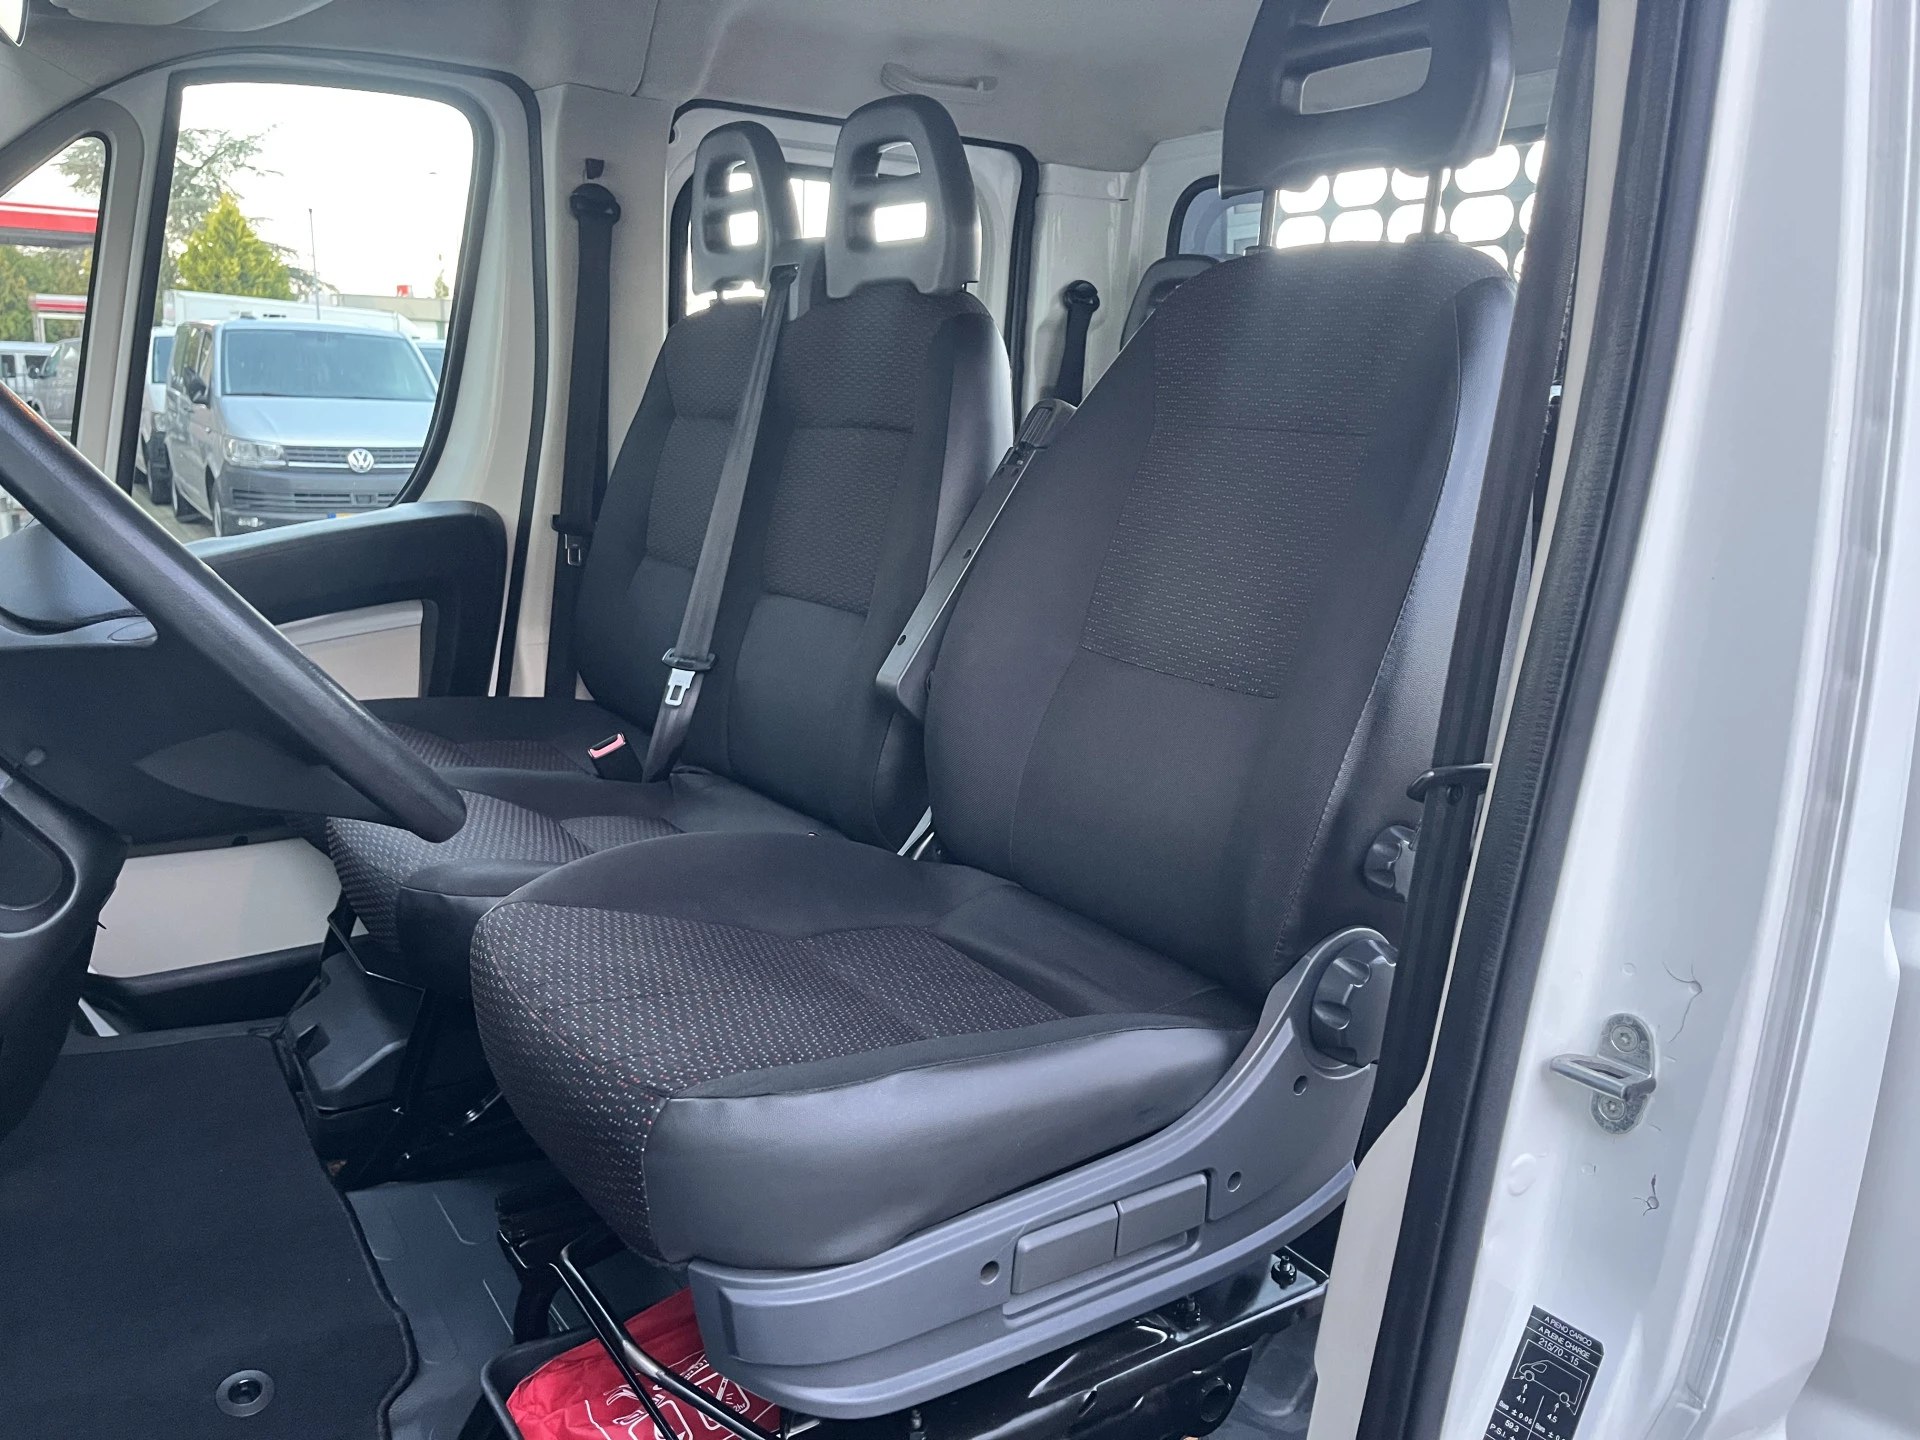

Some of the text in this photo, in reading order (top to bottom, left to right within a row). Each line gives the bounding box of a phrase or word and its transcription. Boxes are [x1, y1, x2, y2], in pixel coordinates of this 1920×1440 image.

[348, 448, 374, 473] VW
[1544, 1328, 1565, 1345] PLEINE
[1564, 1340, 1591, 1360] CHARGE
[1550, 1319, 1569, 1333] PIENO
[1569, 1329, 1592, 1347] CARICO
[1538, 1337, 1564, 1357] 215/70
[1570, 1355, 1580, 1366] 15
[1516, 1395, 1526, 1404] 4.1
[1546, 1413, 1558, 1423] 4.5
